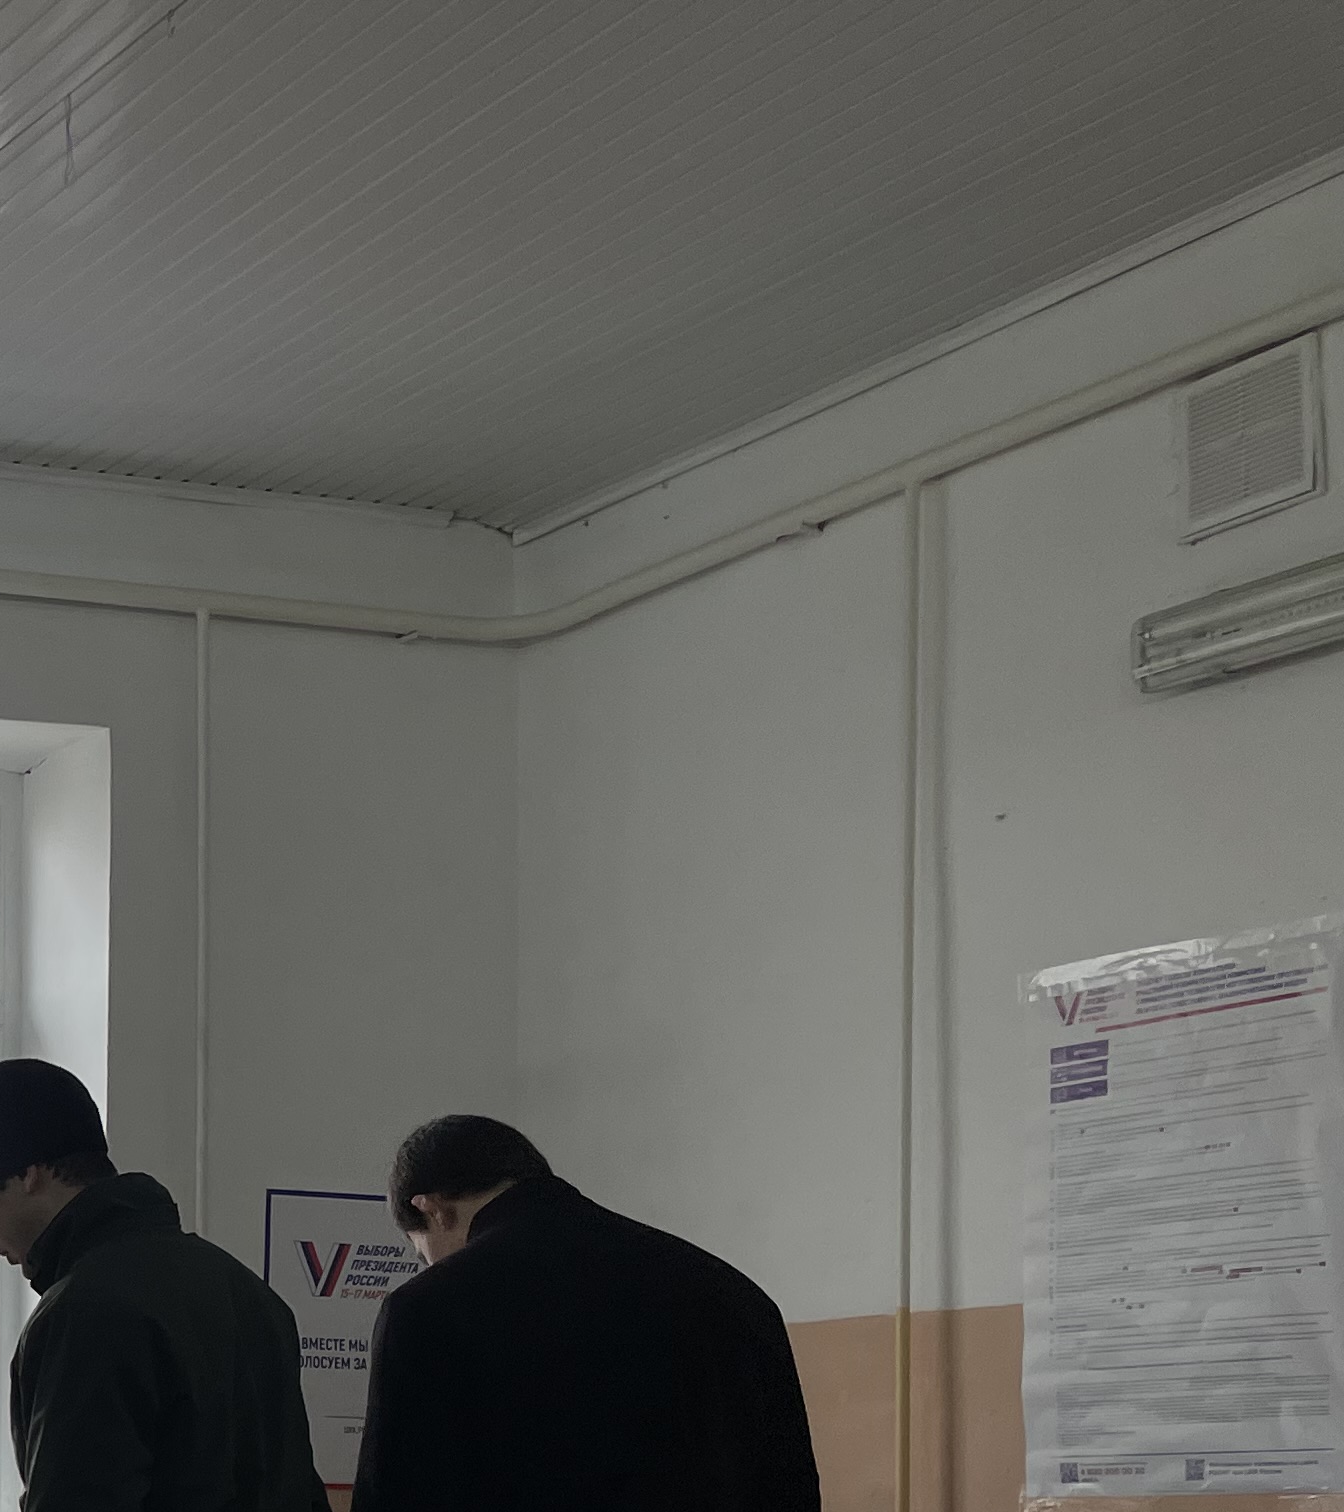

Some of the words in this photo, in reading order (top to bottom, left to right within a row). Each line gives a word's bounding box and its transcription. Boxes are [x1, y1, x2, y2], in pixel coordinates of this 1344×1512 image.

[355, 1244, 406, 1258] ВЫБОРЫ
[350, 1259, 419, 1274] ПРЕЗИДЕНТА
[344, 1274, 390, 1287] РОССИИ
[362, 1289, 390, 1300] МАРТ
[301, 1337, 346, 1351] ВМЕСТЕ
[348, 1339, 368, 1352] МЫ
[353, 1357, 368, 1370] ЗА
